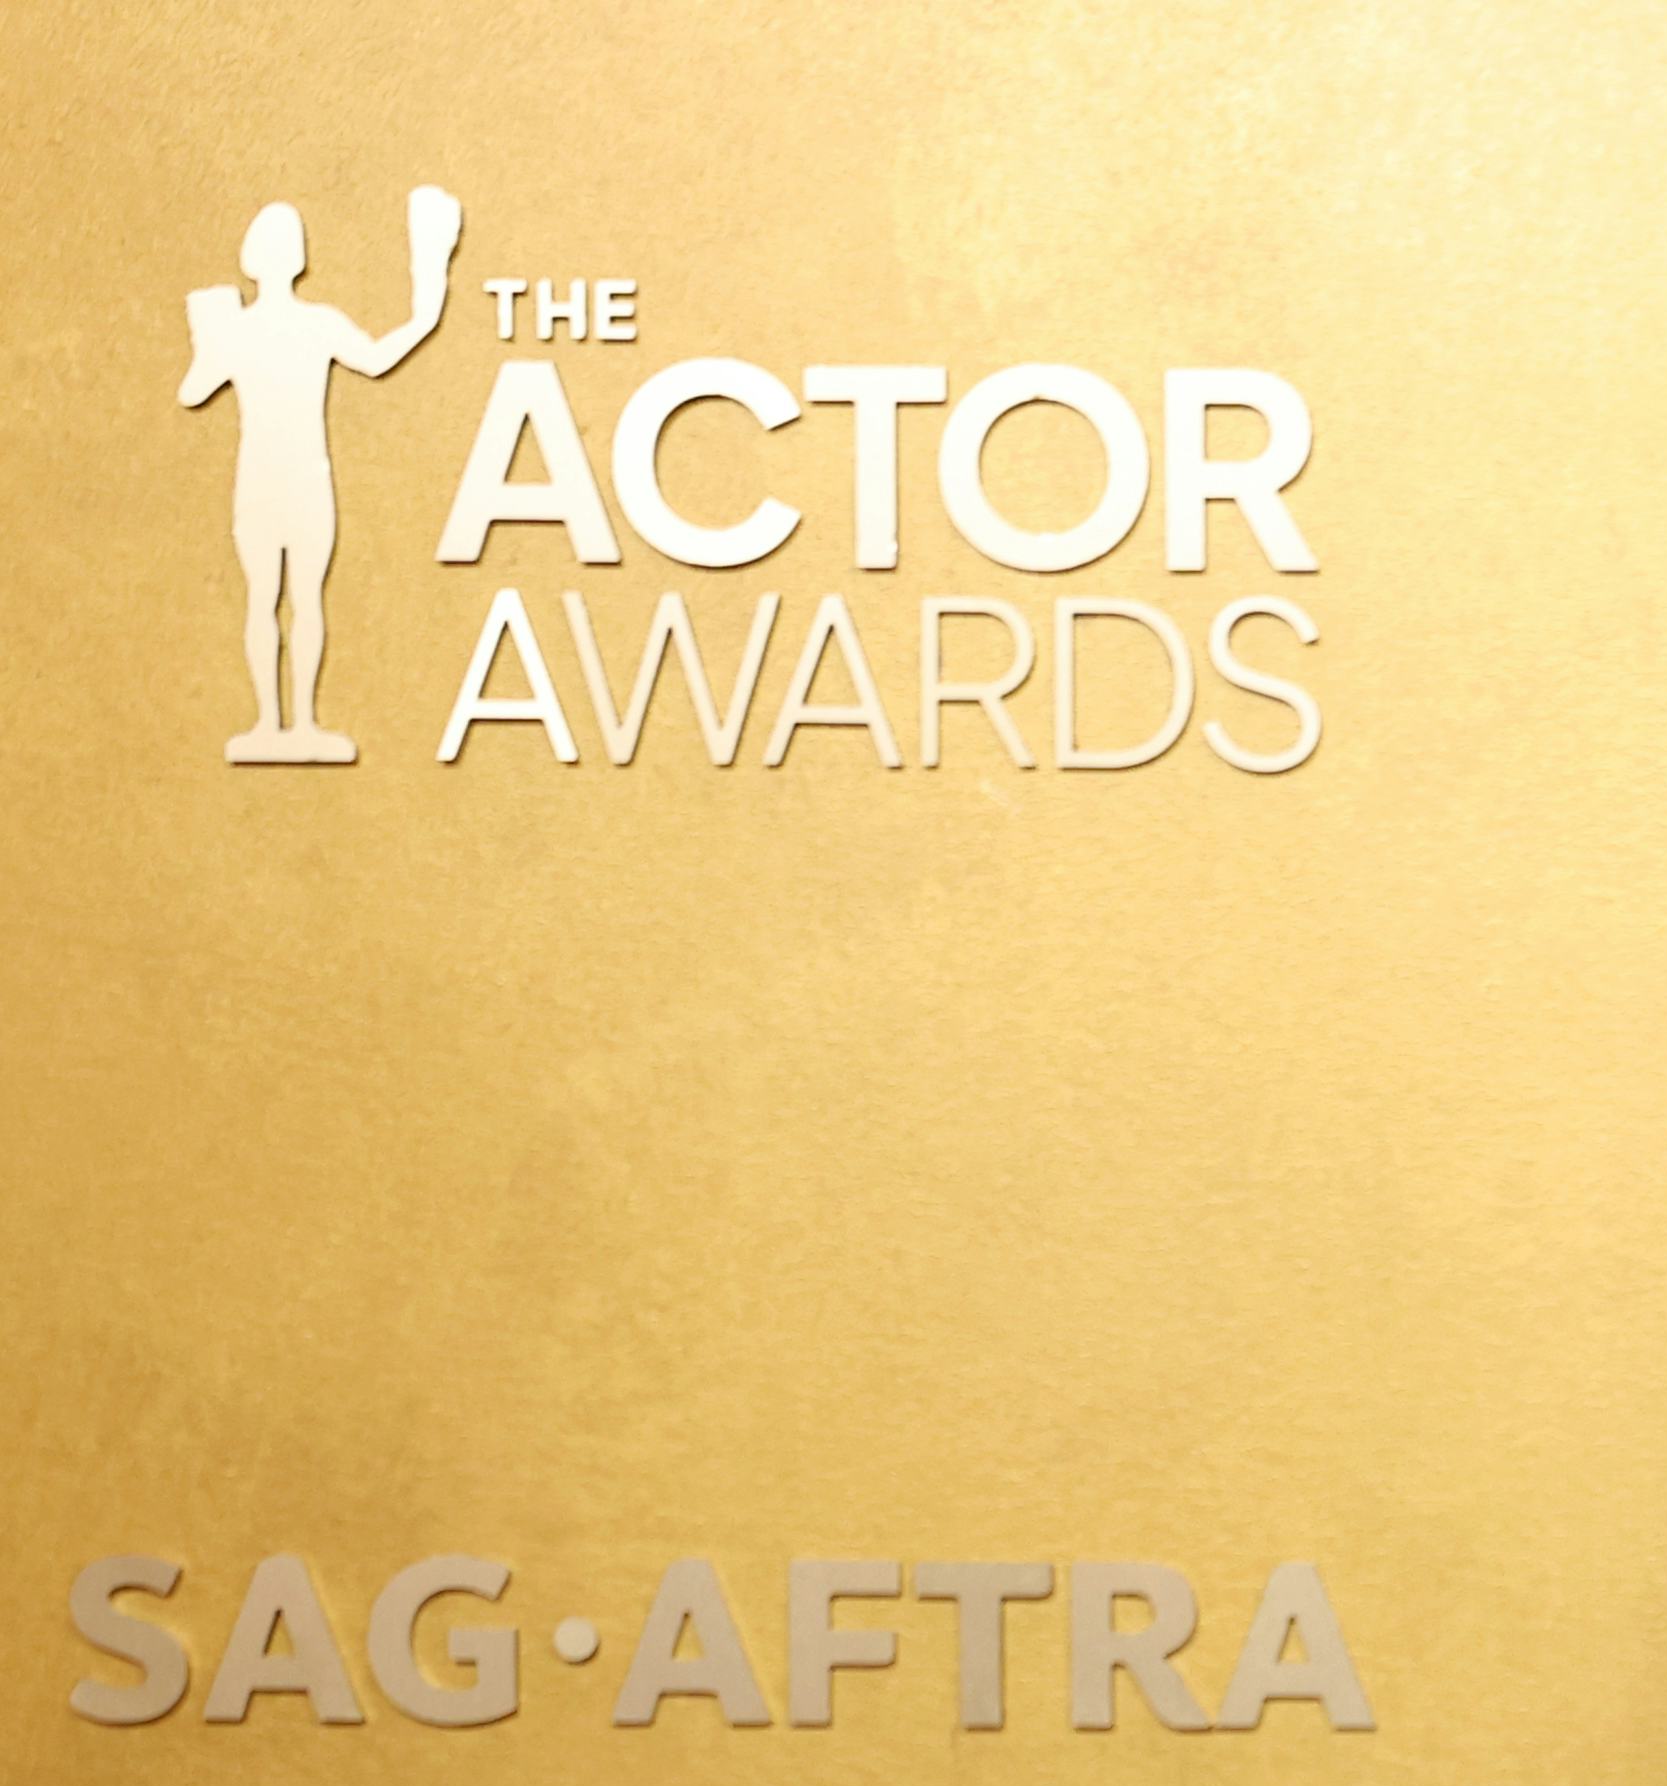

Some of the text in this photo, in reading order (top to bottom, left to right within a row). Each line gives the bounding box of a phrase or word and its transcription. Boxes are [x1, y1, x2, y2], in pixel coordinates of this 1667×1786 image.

[484, 278, 638, 341] THE
[434, 356, 1320, 572] ACTOR
[435, 588, 1322, 774] AWARDS
